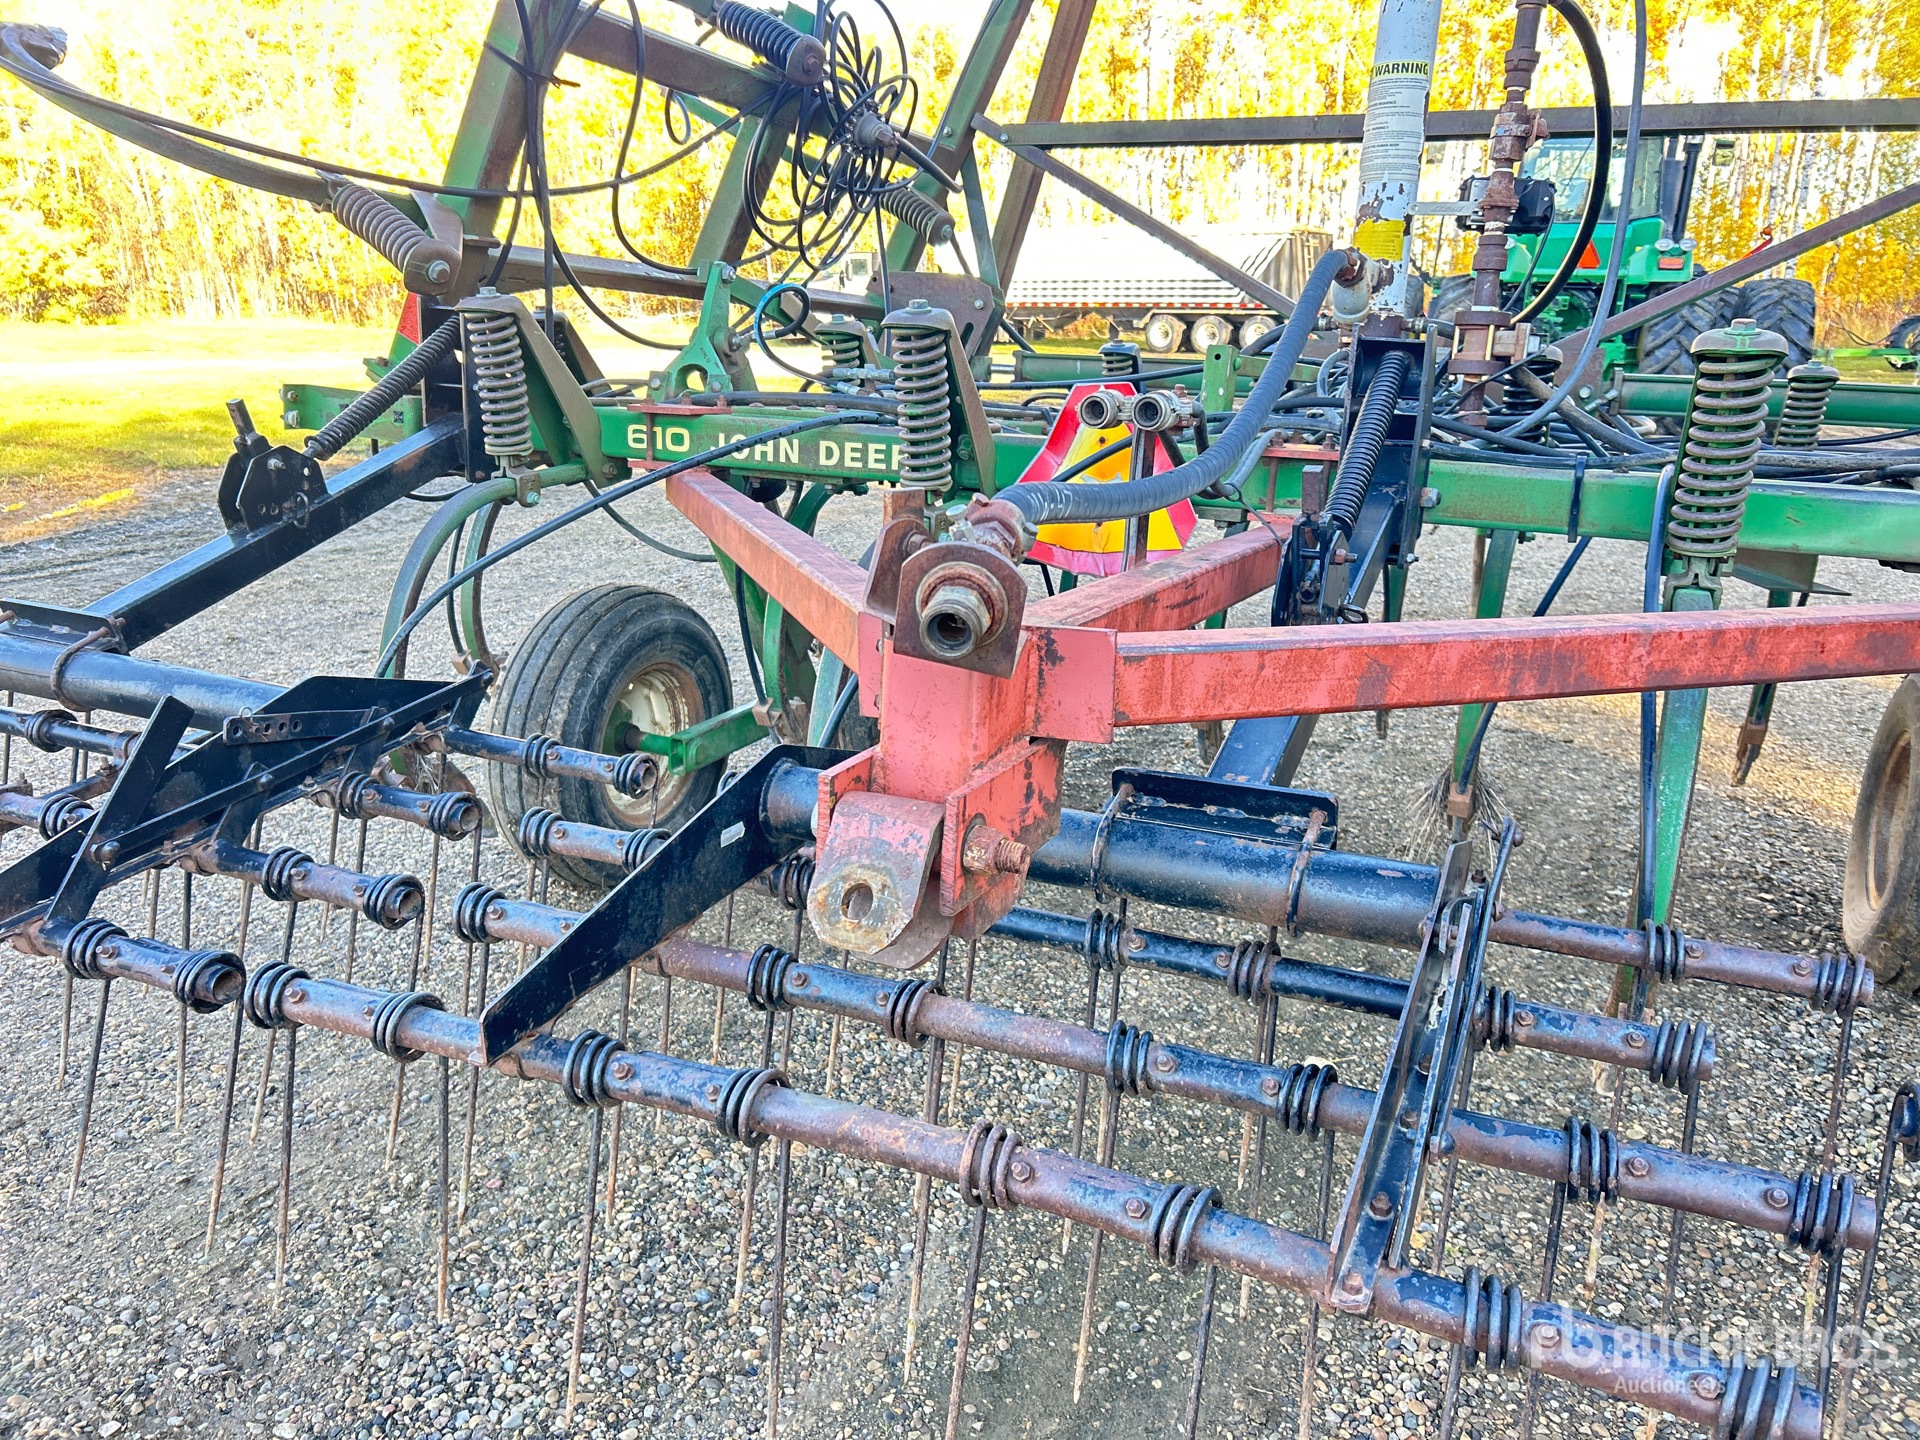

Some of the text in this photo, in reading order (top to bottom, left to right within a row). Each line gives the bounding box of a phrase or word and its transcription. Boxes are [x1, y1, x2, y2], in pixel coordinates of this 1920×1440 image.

[1375, 62, 1428, 77] WARNING
[627, 424, 690, 452] 610
[819, 440, 909, 471] DEER
